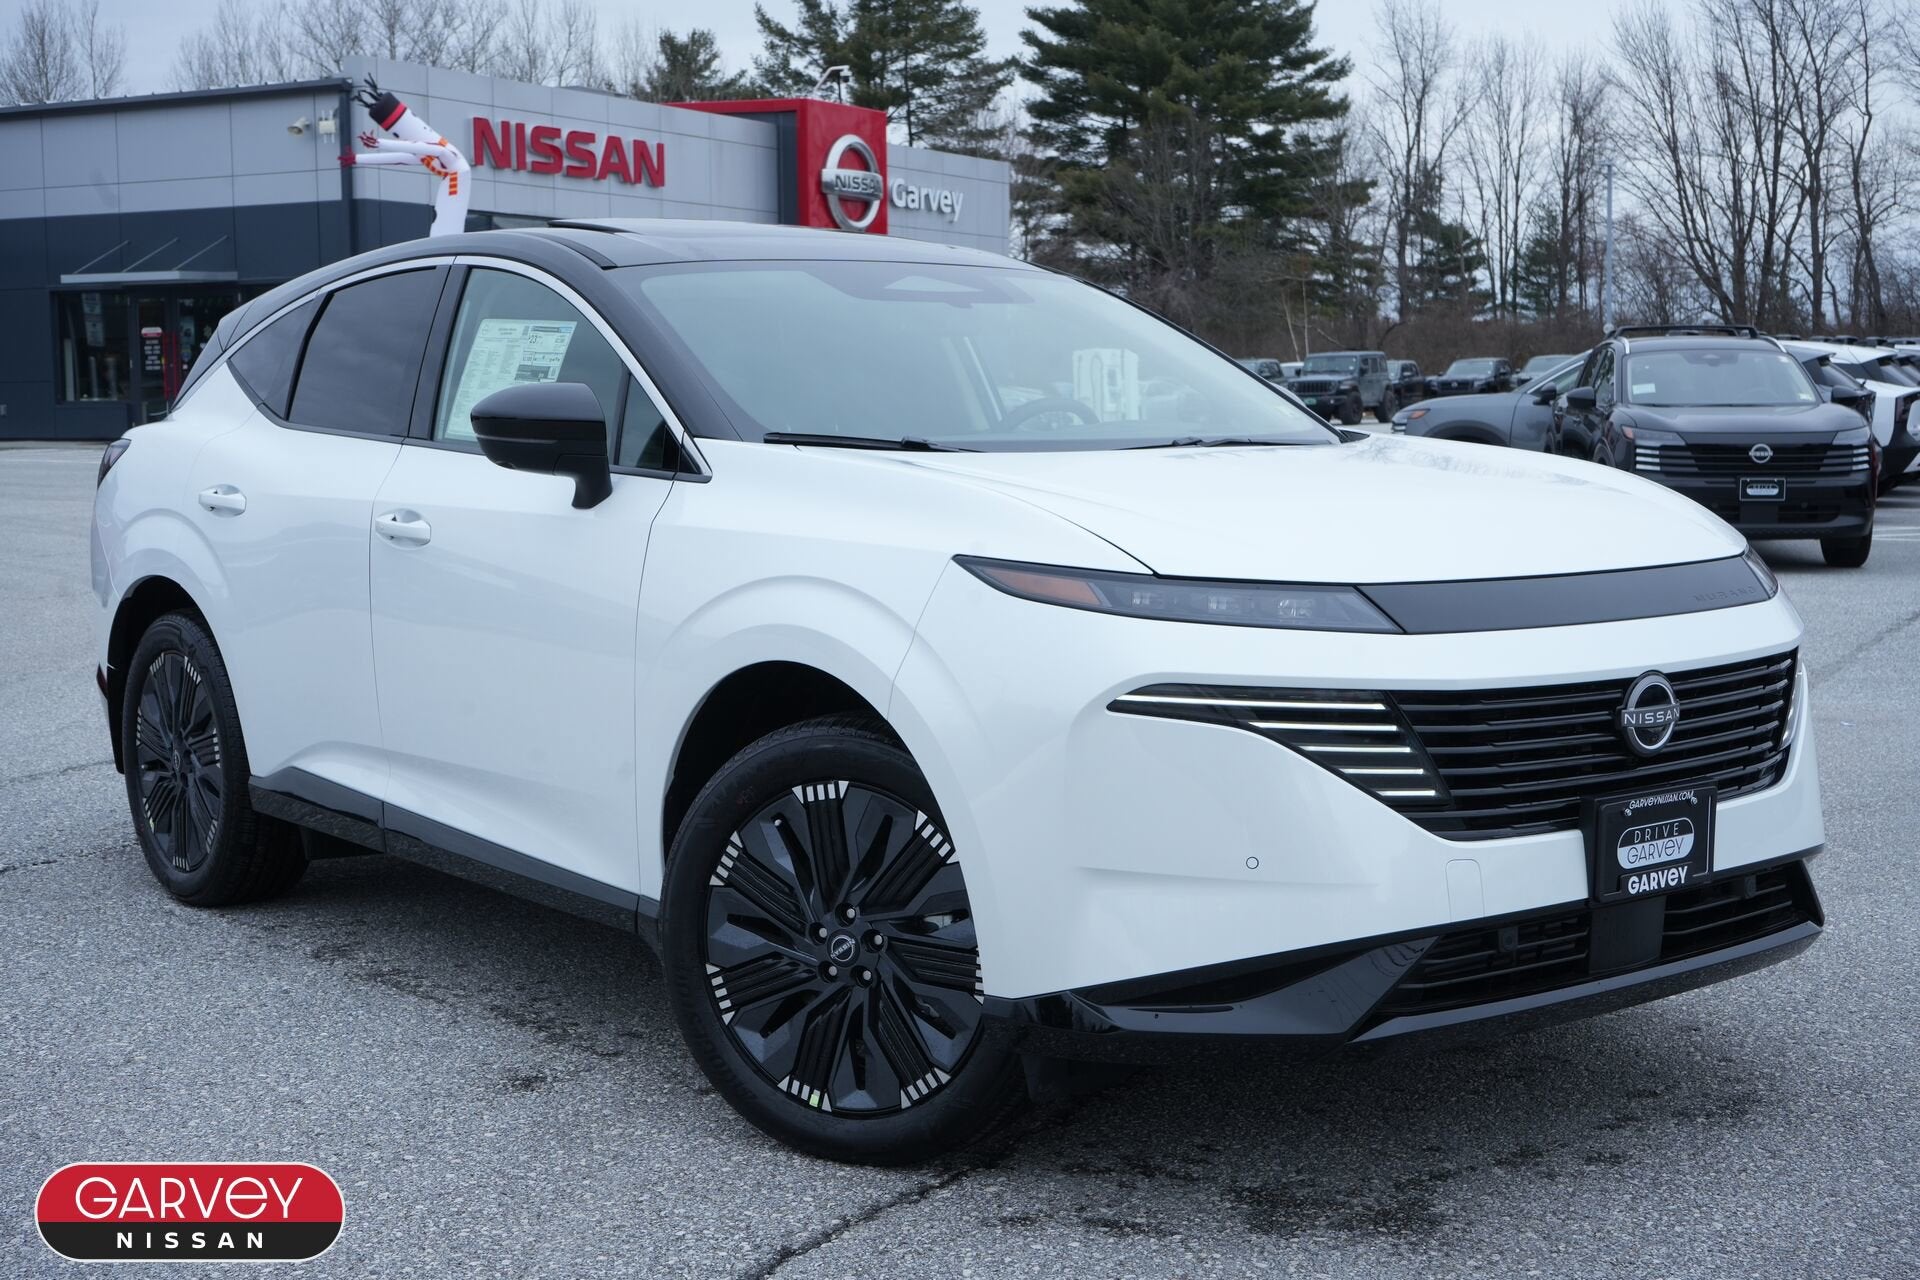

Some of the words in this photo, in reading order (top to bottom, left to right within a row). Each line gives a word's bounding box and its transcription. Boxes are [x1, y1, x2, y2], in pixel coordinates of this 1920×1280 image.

[472, 115, 666, 188] NISSAN
[892, 178, 964, 222] Garvey
[1624, 707, 1680, 725] NISSAN
[1633, 822, 1680, 844] DRIVE
